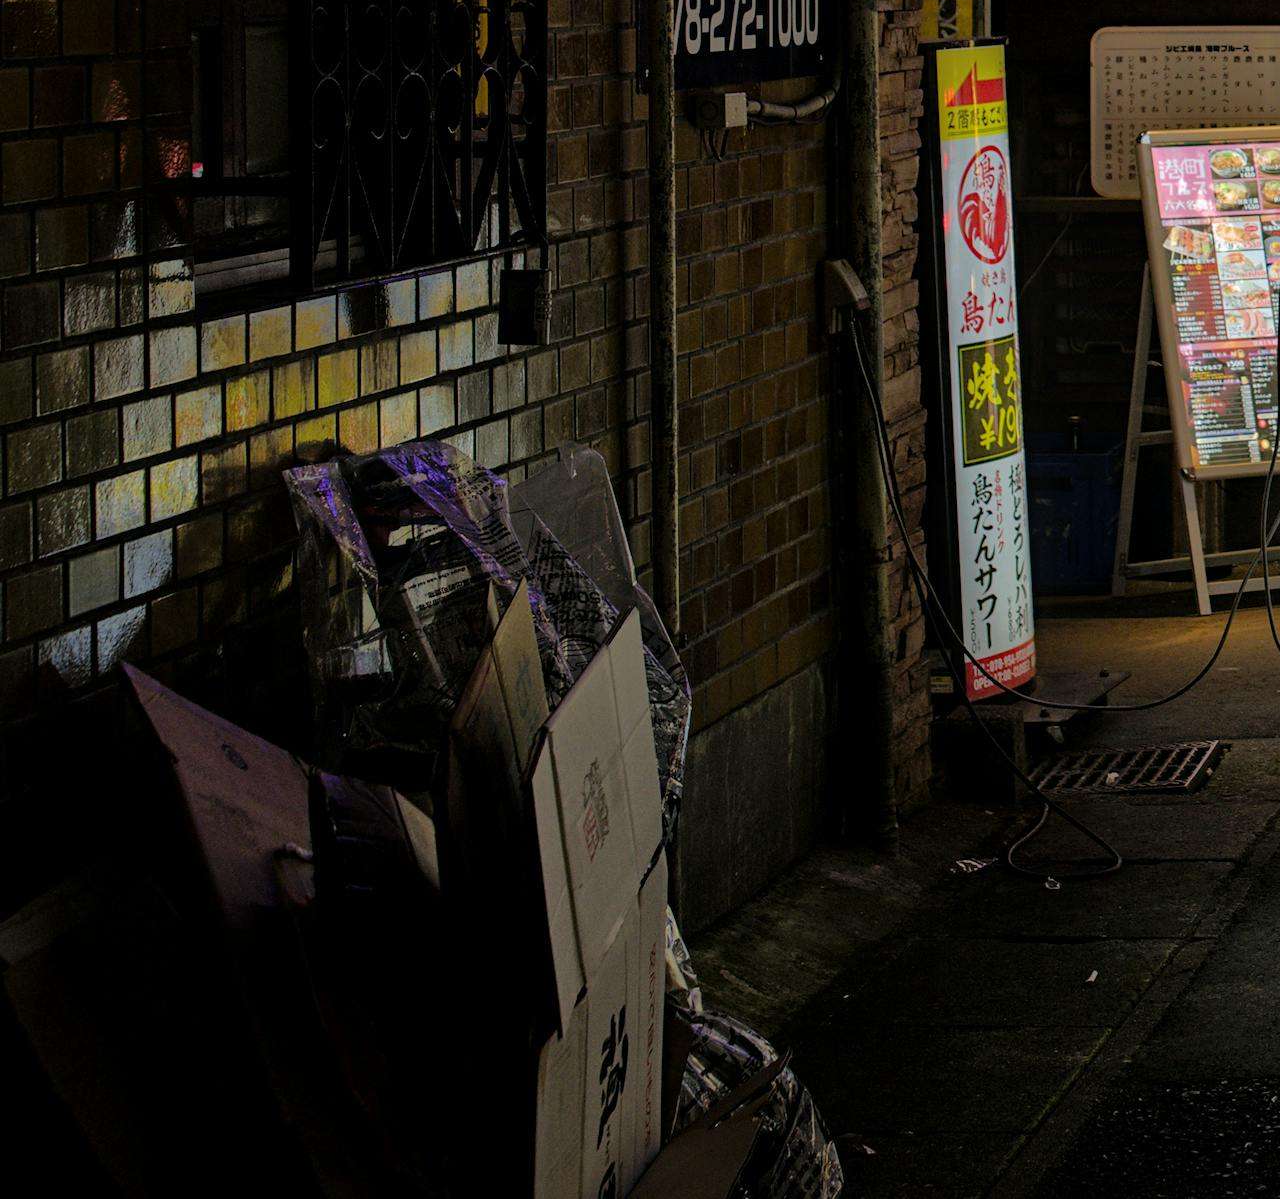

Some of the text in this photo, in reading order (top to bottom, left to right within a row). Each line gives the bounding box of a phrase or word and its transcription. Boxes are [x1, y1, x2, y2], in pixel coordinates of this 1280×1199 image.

[971, 473, 998, 649] 鳥たんサワー
